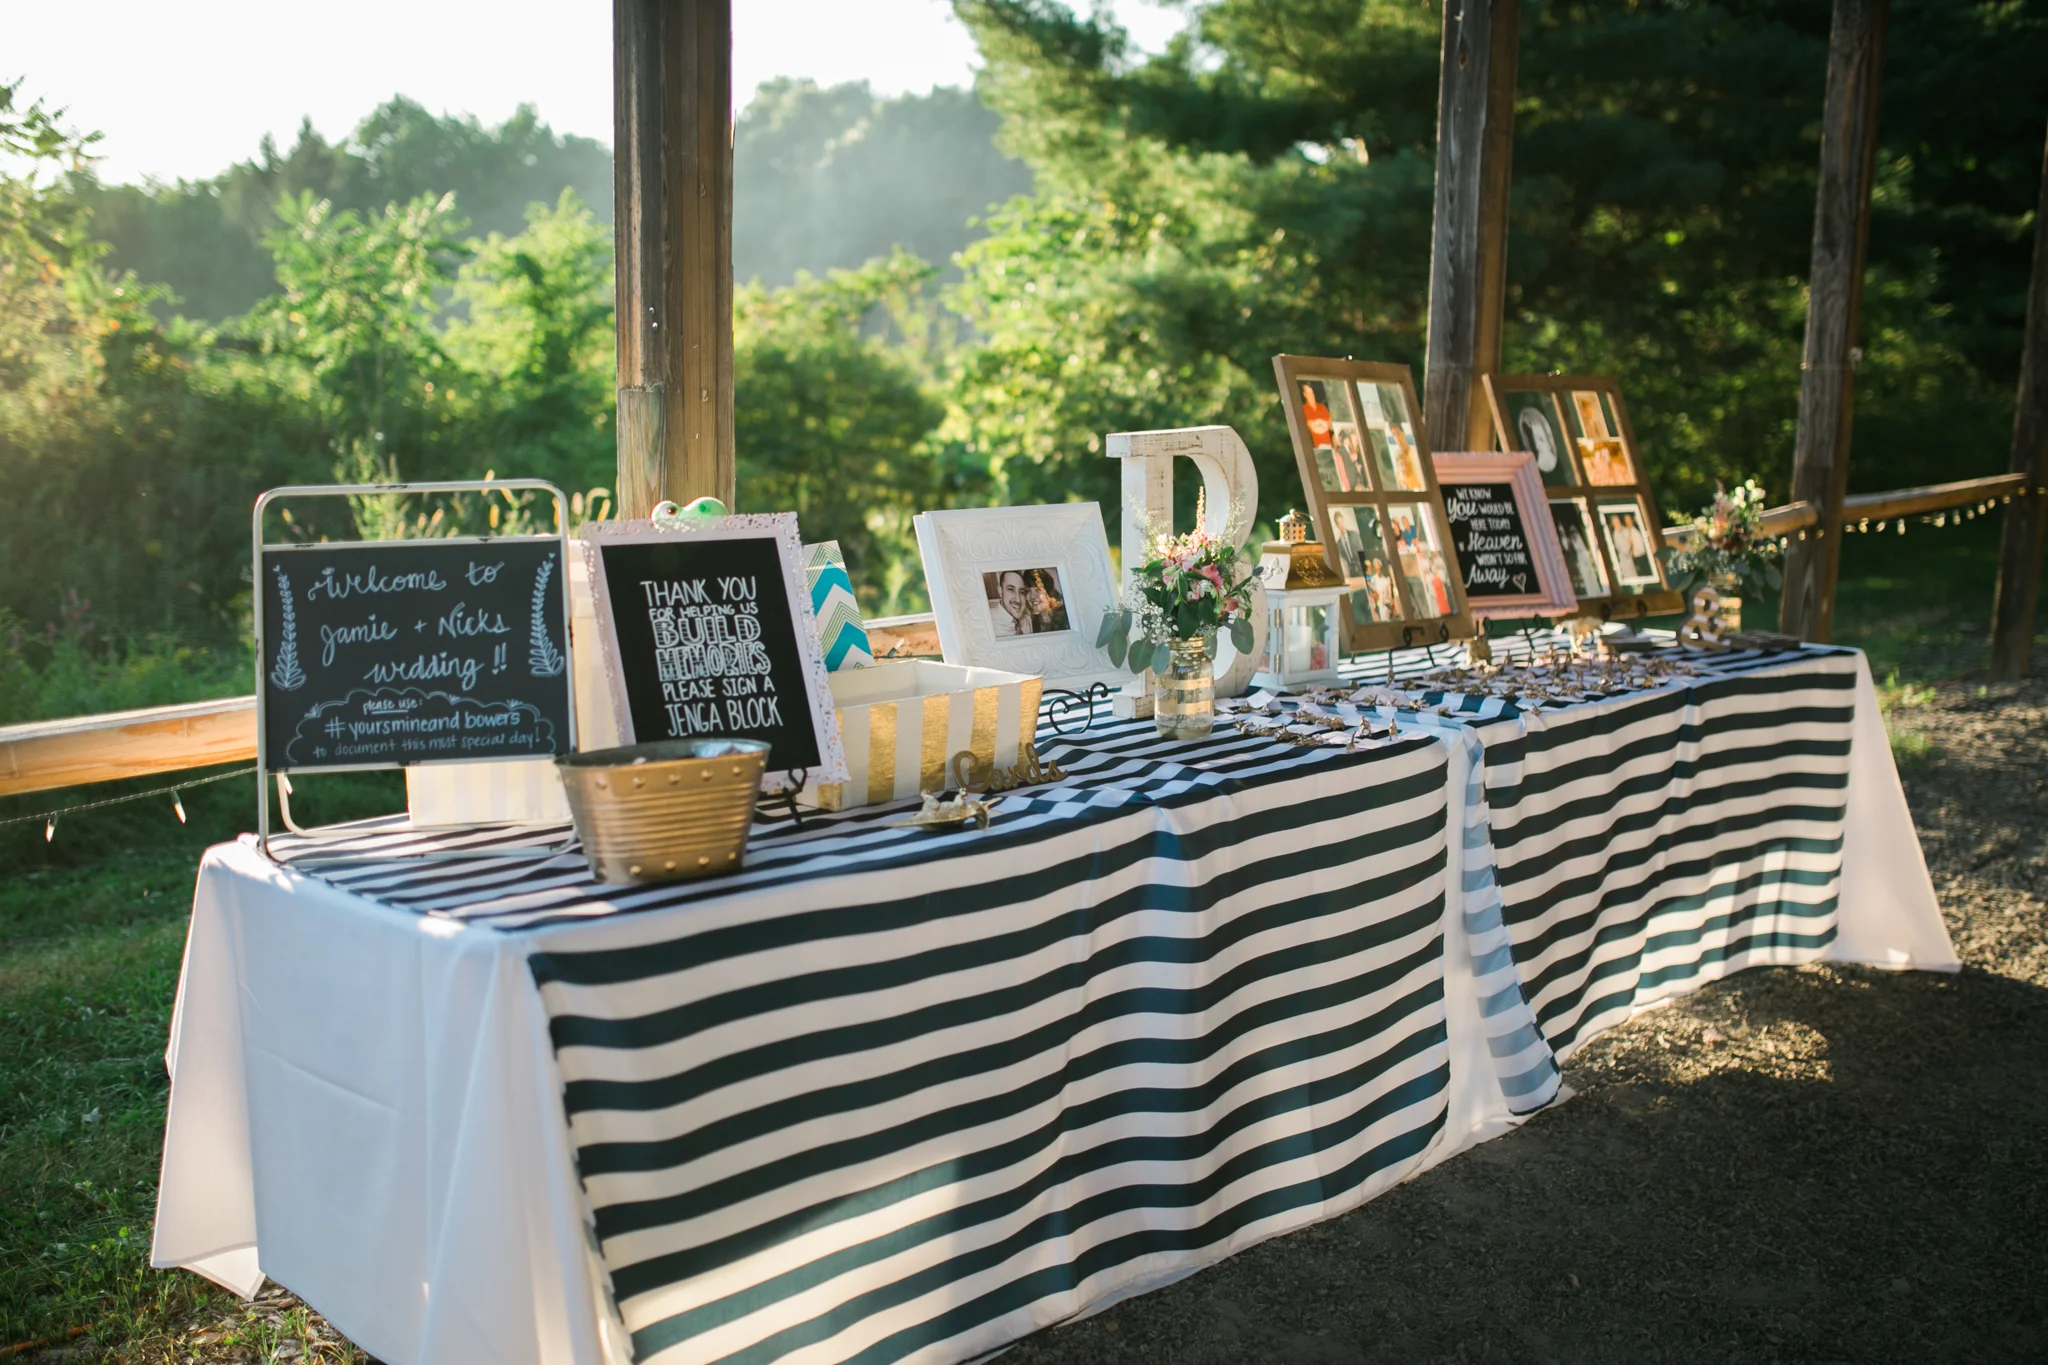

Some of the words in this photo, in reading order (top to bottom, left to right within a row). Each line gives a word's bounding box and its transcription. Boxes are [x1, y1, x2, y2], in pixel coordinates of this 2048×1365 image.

[1468, 532, 1523, 552] Heaven
[464, 561, 505, 586] to
[1464, 564, 1510, 589] Away
[640, 578, 712, 607] THANK
[717, 576, 757, 601] YOU
[648, 608, 675, 621] FOR
[680, 604, 735, 619] HELPING
[740, 602, 759, 615] US
[321, 614, 397, 666] Jamie
[414, 620, 427, 632] +
[651, 614, 762, 648] BUILD
[363, 652, 484, 690] wedding
[655, 641, 771, 682] MEMORIES
[662, 681, 716, 702] PLEASE
[722, 678, 757, 696] SIGN
[763, 676, 775, 691] A
[363, 700, 395, 715] please
[664, 702, 724, 736] JENGA
[726, 696, 783, 730] BLOCK
[313, 746, 327, 758] to
[334, 738, 396, 756] document
[401, 733, 426, 751] this
[461, 733, 505, 749] special
[953, 743, 1068, 793] Cards
